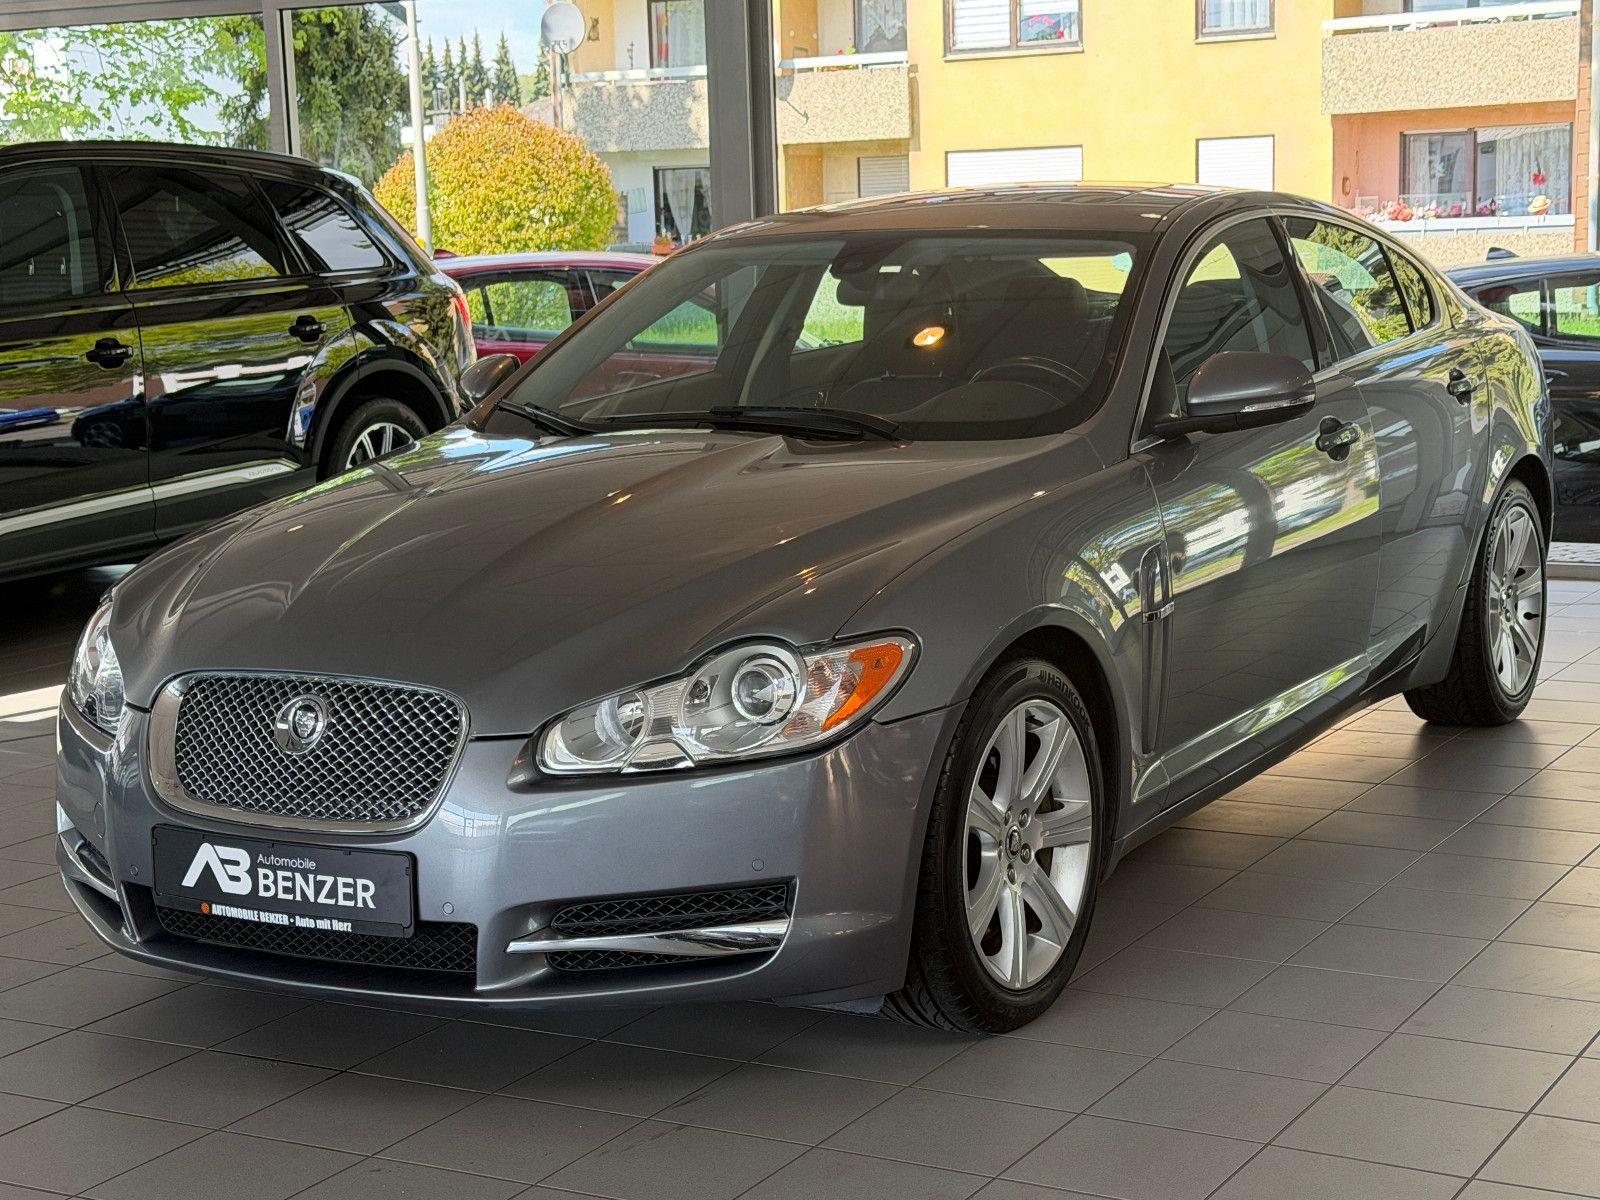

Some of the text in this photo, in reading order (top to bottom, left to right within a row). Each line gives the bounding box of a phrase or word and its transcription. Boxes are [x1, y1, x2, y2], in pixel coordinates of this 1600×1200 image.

[257, 853, 316, 870] Automobile
[256, 867, 376, 909] BENZER
[211, 904, 353, 933] AUTOMOBILE BENZER Auto mit Herz
